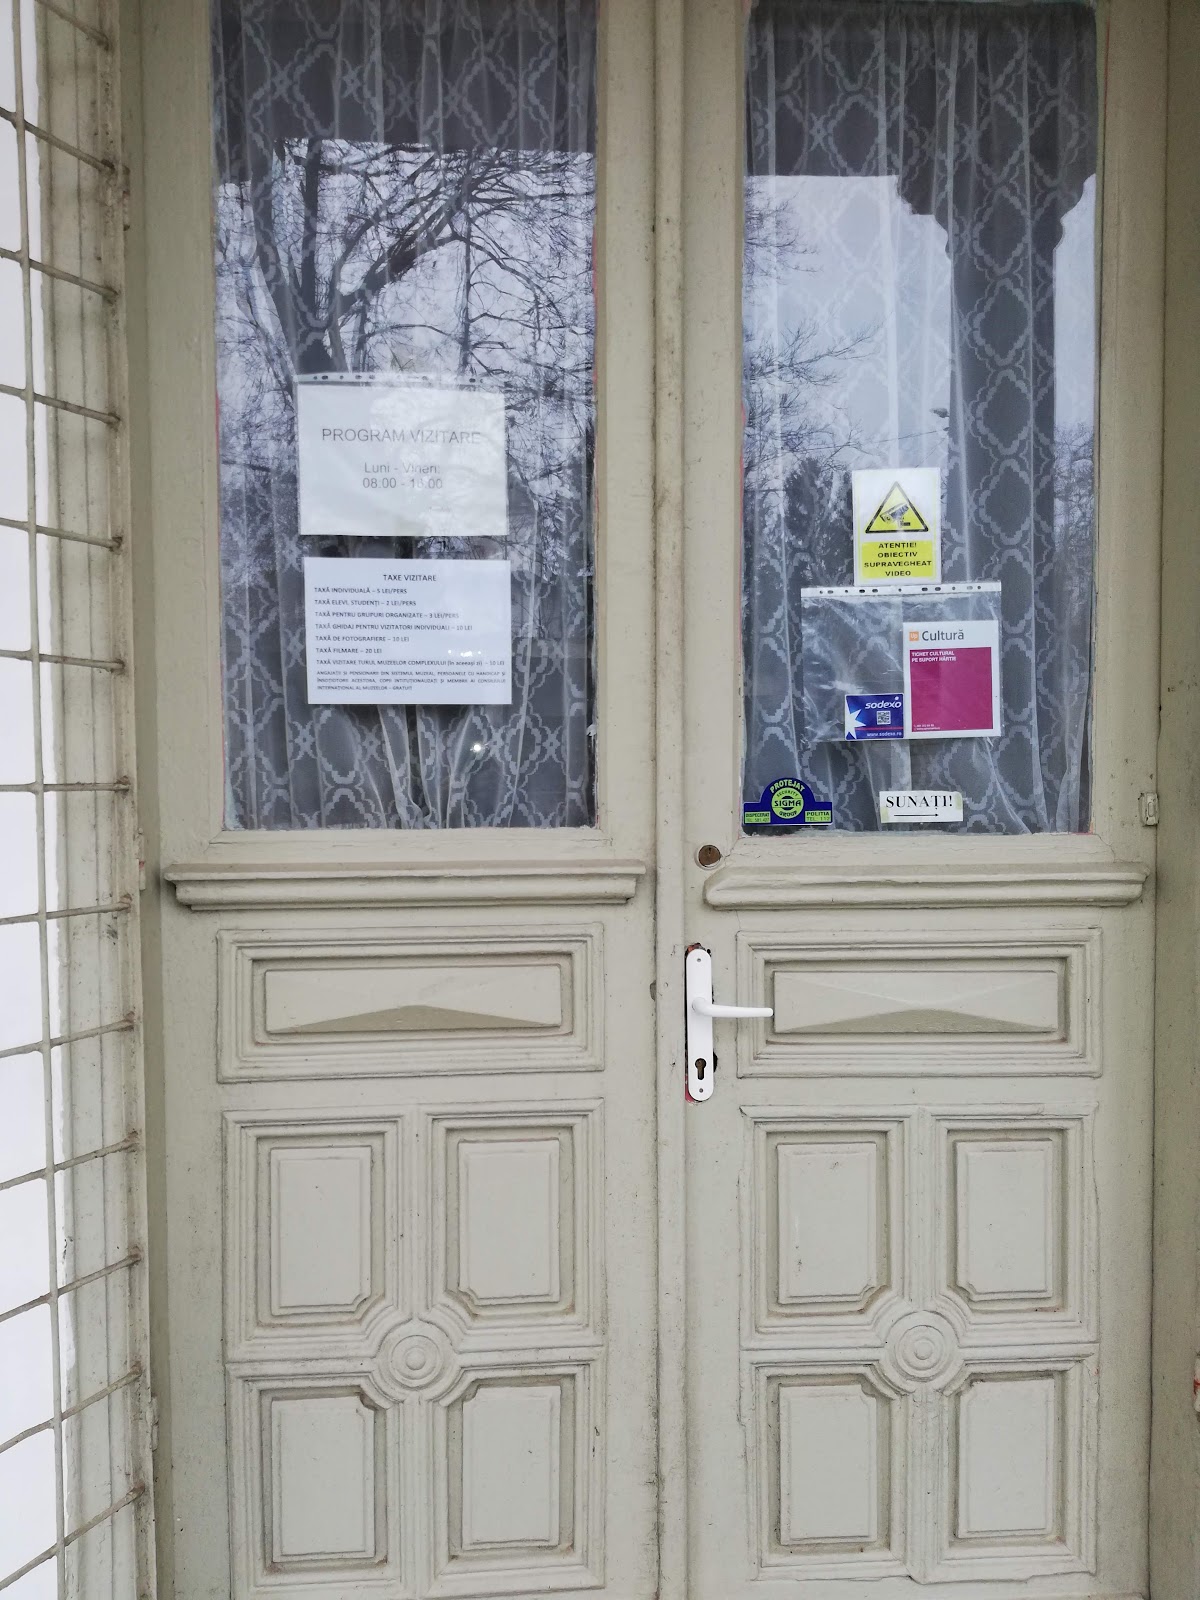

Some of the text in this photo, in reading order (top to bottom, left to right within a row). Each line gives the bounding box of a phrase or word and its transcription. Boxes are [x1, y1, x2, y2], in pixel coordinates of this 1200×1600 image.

[322, 428, 482, 445] PROGRAM VIZITARE
[364, 462, 390, 473] Luni
[922, 629, 965, 641] Cultură
[865, 699, 902, 710] sodexo
[769, 779, 806, 794] PROTEJAT
[776, 789, 798, 798] SECURITY
[774, 799, 802, 807] SIGMA
[885, 795, 953, 810] SUNAȚI!
